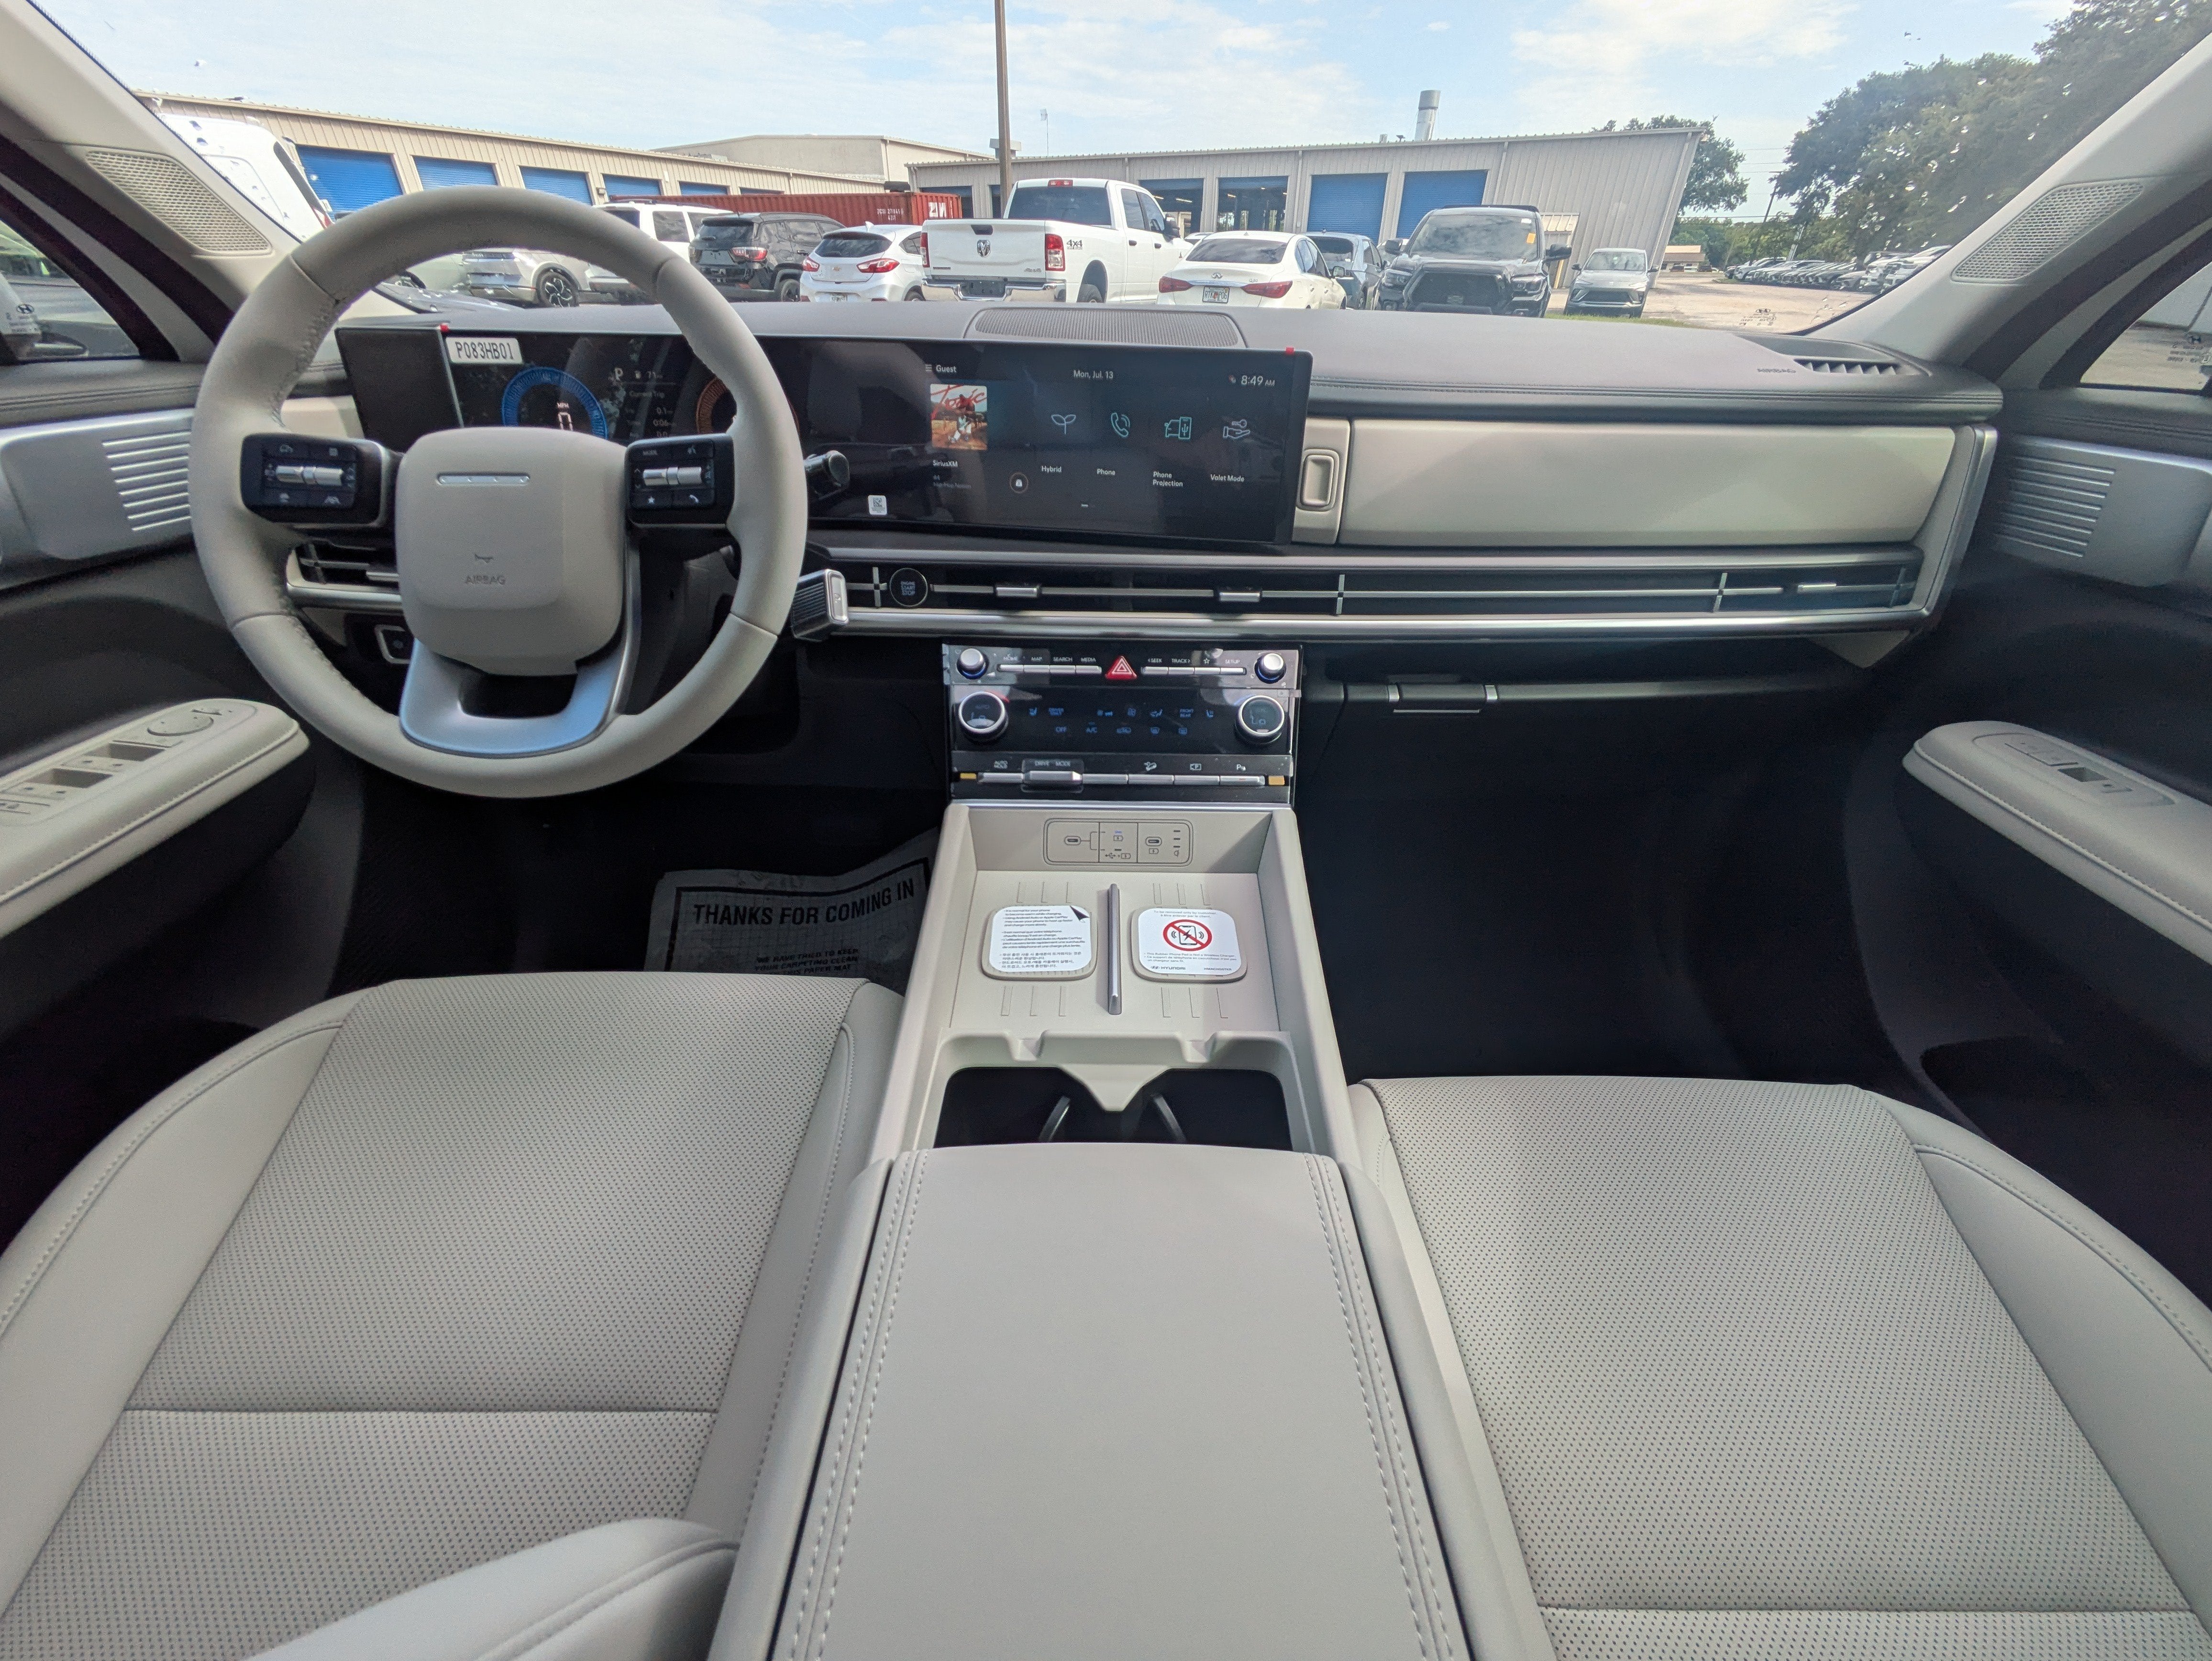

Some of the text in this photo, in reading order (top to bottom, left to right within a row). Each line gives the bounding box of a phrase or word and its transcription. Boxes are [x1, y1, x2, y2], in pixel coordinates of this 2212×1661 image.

[455, 341, 514, 360] P083HB01
[615, 367, 623, 381] P
[936, 365, 956, 373] Guest
[1073, 370, 1114, 379] Mon, Jul. 13
[1240, 375, 1263, 386] 8:49
[1152, 479, 1183, 487] Projection
[465, 575, 505, 585] AIRBAG
[694, 877, 915, 925] THANKS FOR COMING IN
